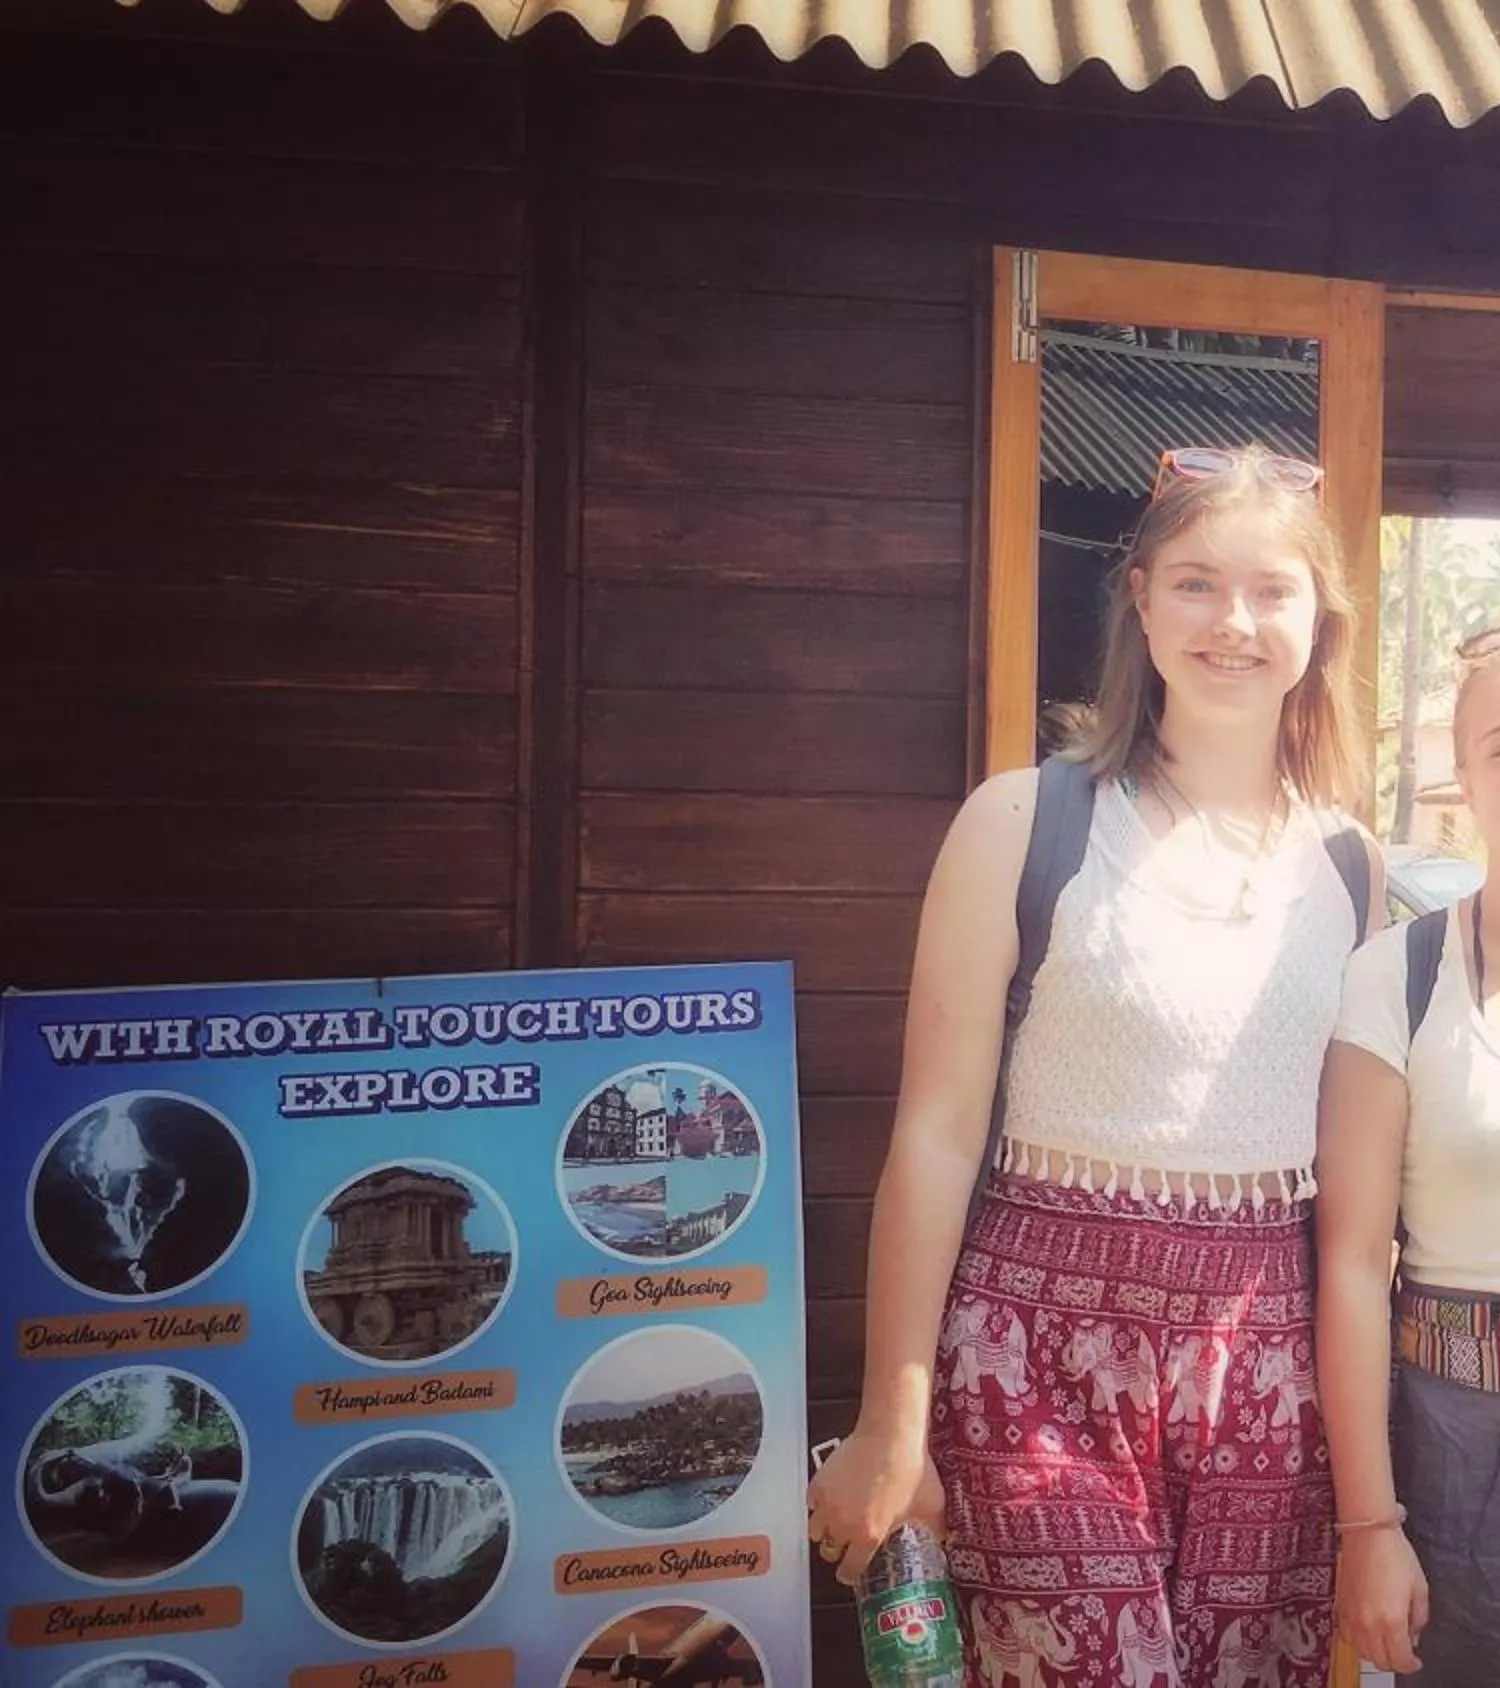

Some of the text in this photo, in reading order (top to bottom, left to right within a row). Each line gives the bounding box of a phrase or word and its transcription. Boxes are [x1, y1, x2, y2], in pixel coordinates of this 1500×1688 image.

[40, 989, 759, 1063] WITH ROYAL TOUCH TOURS
[279, 1063, 536, 1115] EXPLORE
[633, 1275, 734, 1306] Sightseeing
[143, 1311, 242, 1343] Waterfall
[315, 1378, 497, 1414] Hampi and Badami
[658, 1546, 760, 1579] Sightseeing
[44, 1603, 136, 1637] Elephant
[399, 1660, 450, 1687] Falls
